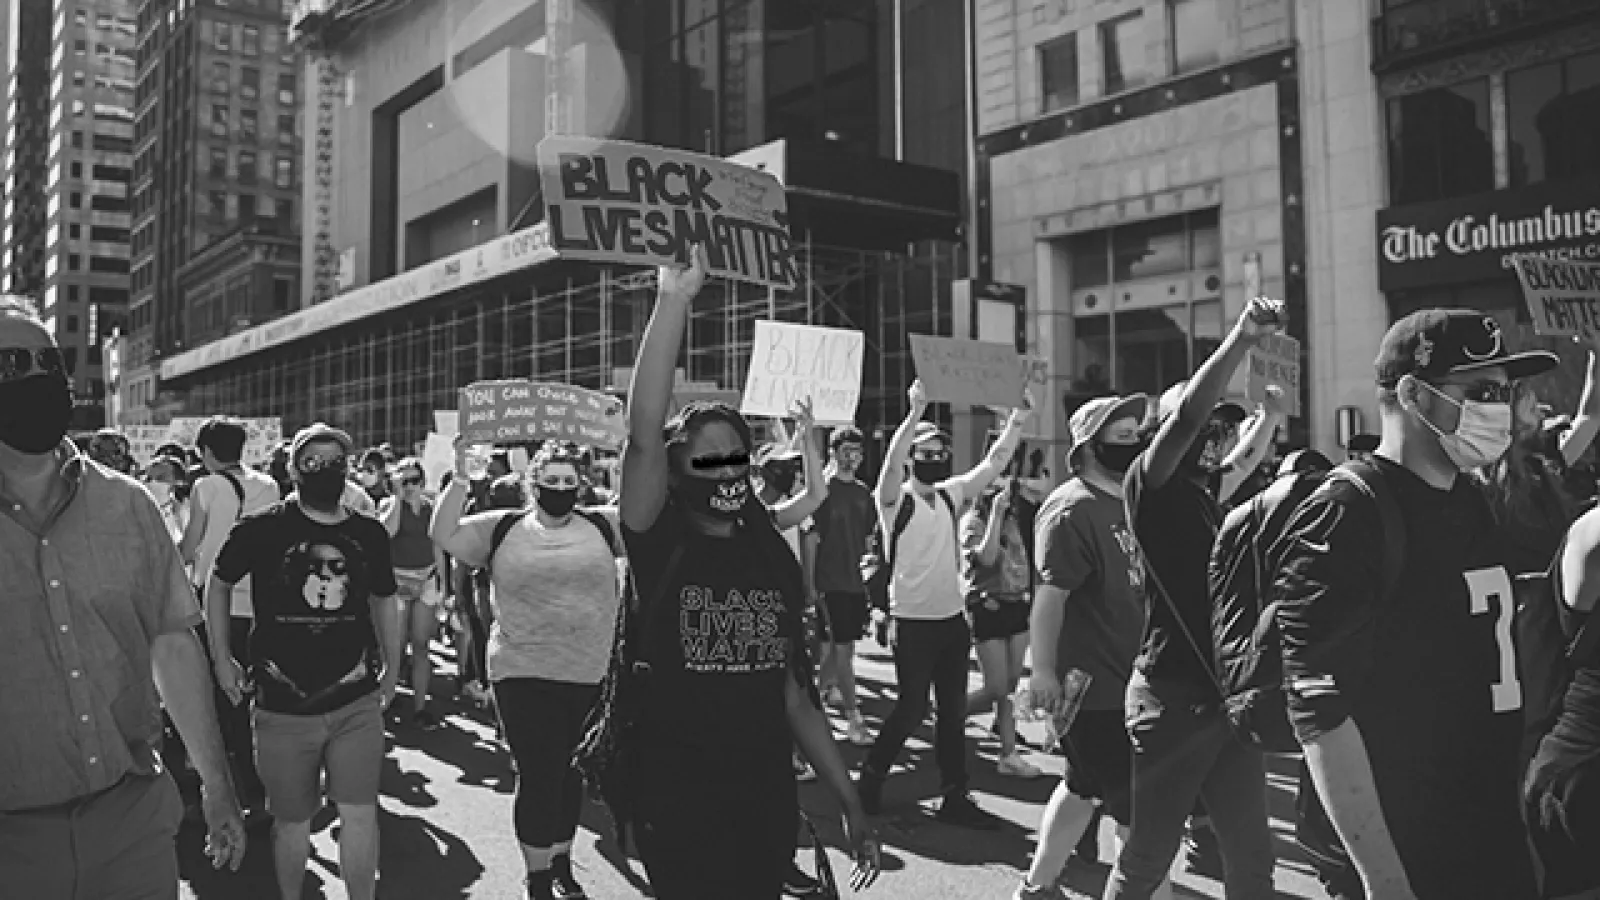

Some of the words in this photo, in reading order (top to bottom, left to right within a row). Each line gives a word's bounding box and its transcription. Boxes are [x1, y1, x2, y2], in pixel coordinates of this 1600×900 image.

[560, 154, 722, 210] BLACK
[548, 203, 675, 257] LIVES
[671, 208, 797, 284] MATTER
[1381, 224, 1440, 262] The
[1445, 204, 1600, 255] Columbus
[766, 328, 860, 382] BLACK
[465, 387, 495, 407] YOU
[501, 386, 530, 401] CAN
[680, 611, 778, 636] LIVES
[1462, 565, 1523, 711] 7
